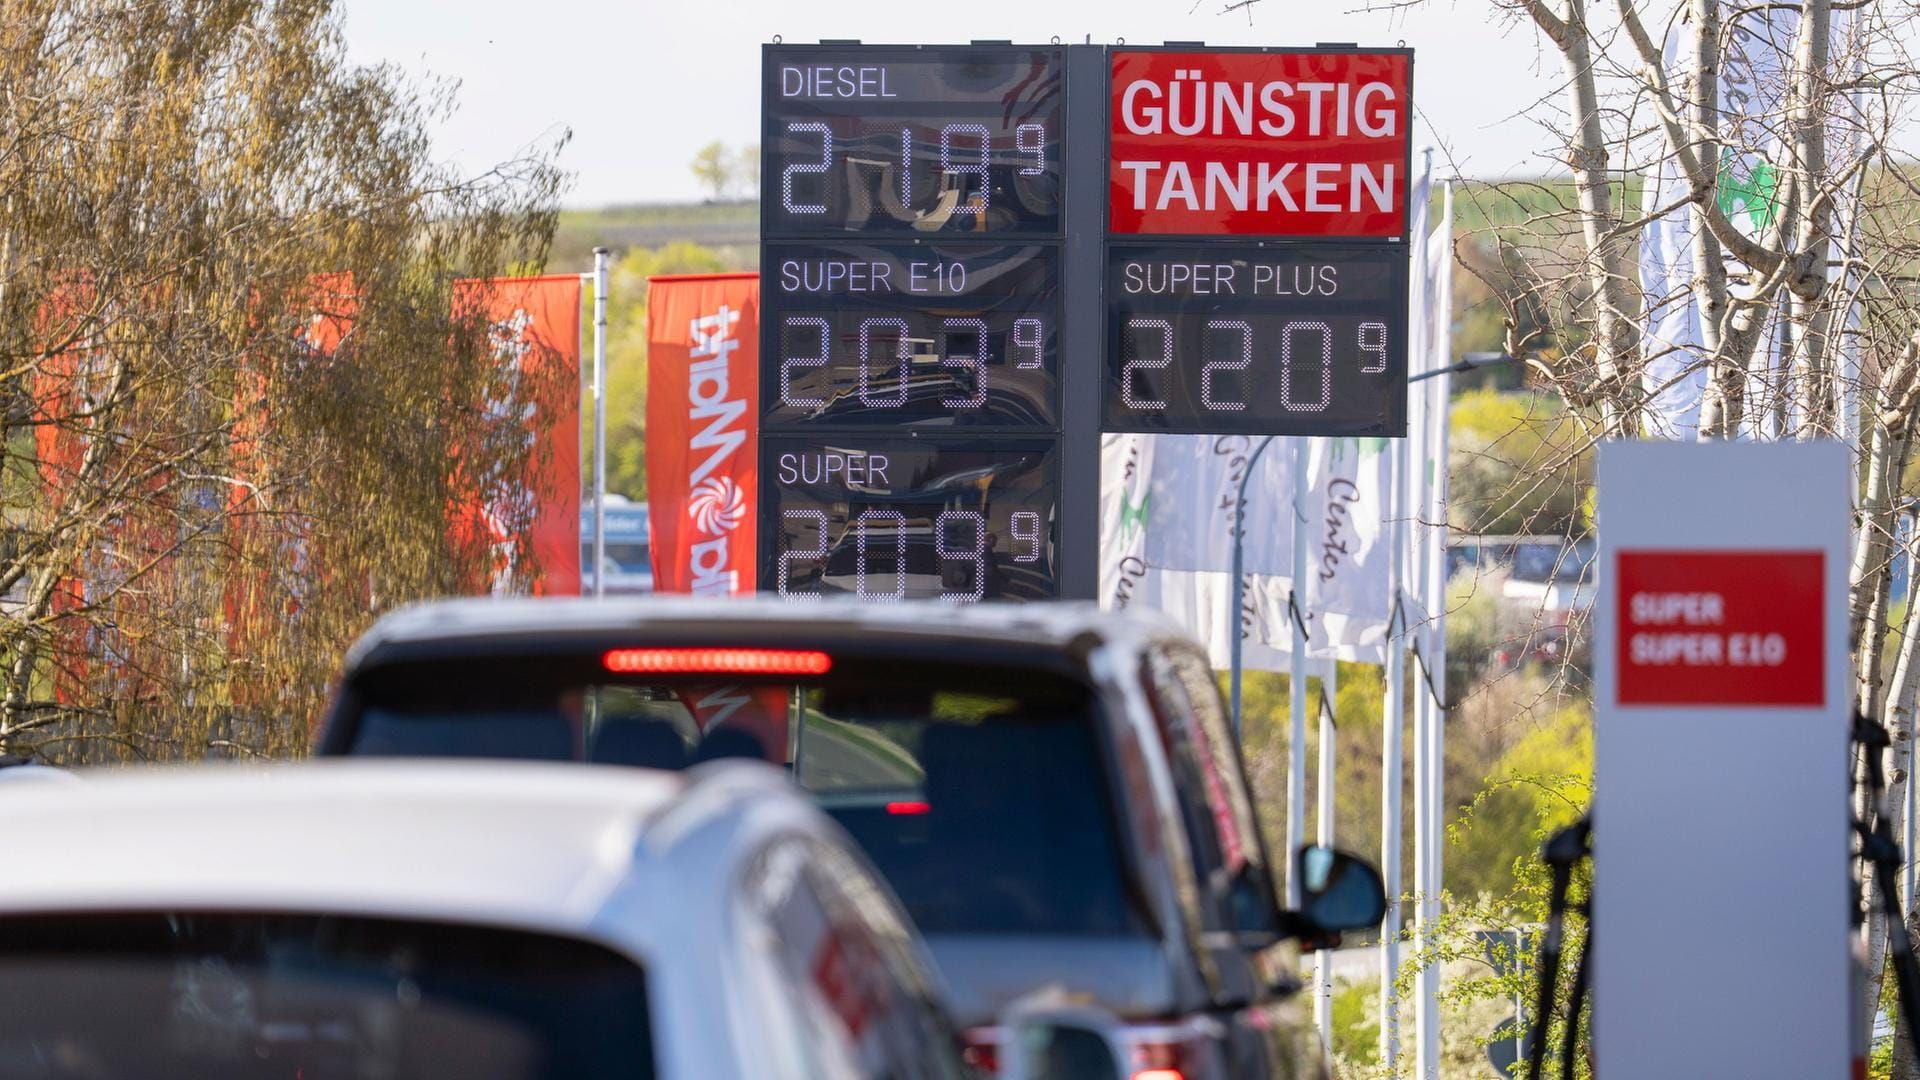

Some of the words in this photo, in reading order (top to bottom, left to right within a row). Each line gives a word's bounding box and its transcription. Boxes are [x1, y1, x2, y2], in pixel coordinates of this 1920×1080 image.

[782, 67, 897, 97] DIESEL
[1121, 69, 1396, 138] GÜNSTIG
[1120, 160, 1394, 213] TANKEN
[781, 261, 891, 292] SUPER
[910, 262, 966, 292] E10
[1124, 263, 1235, 294] SUPER
[1254, 265, 1337, 296] PLUS
[779, 454, 889, 484] SUPER
[1319, 478, 1361, 583] Center
[1631, 593, 1724, 624] SUPER
[1631, 633, 1723, 665] SUPER
[1727, 634, 1786, 665] E10
